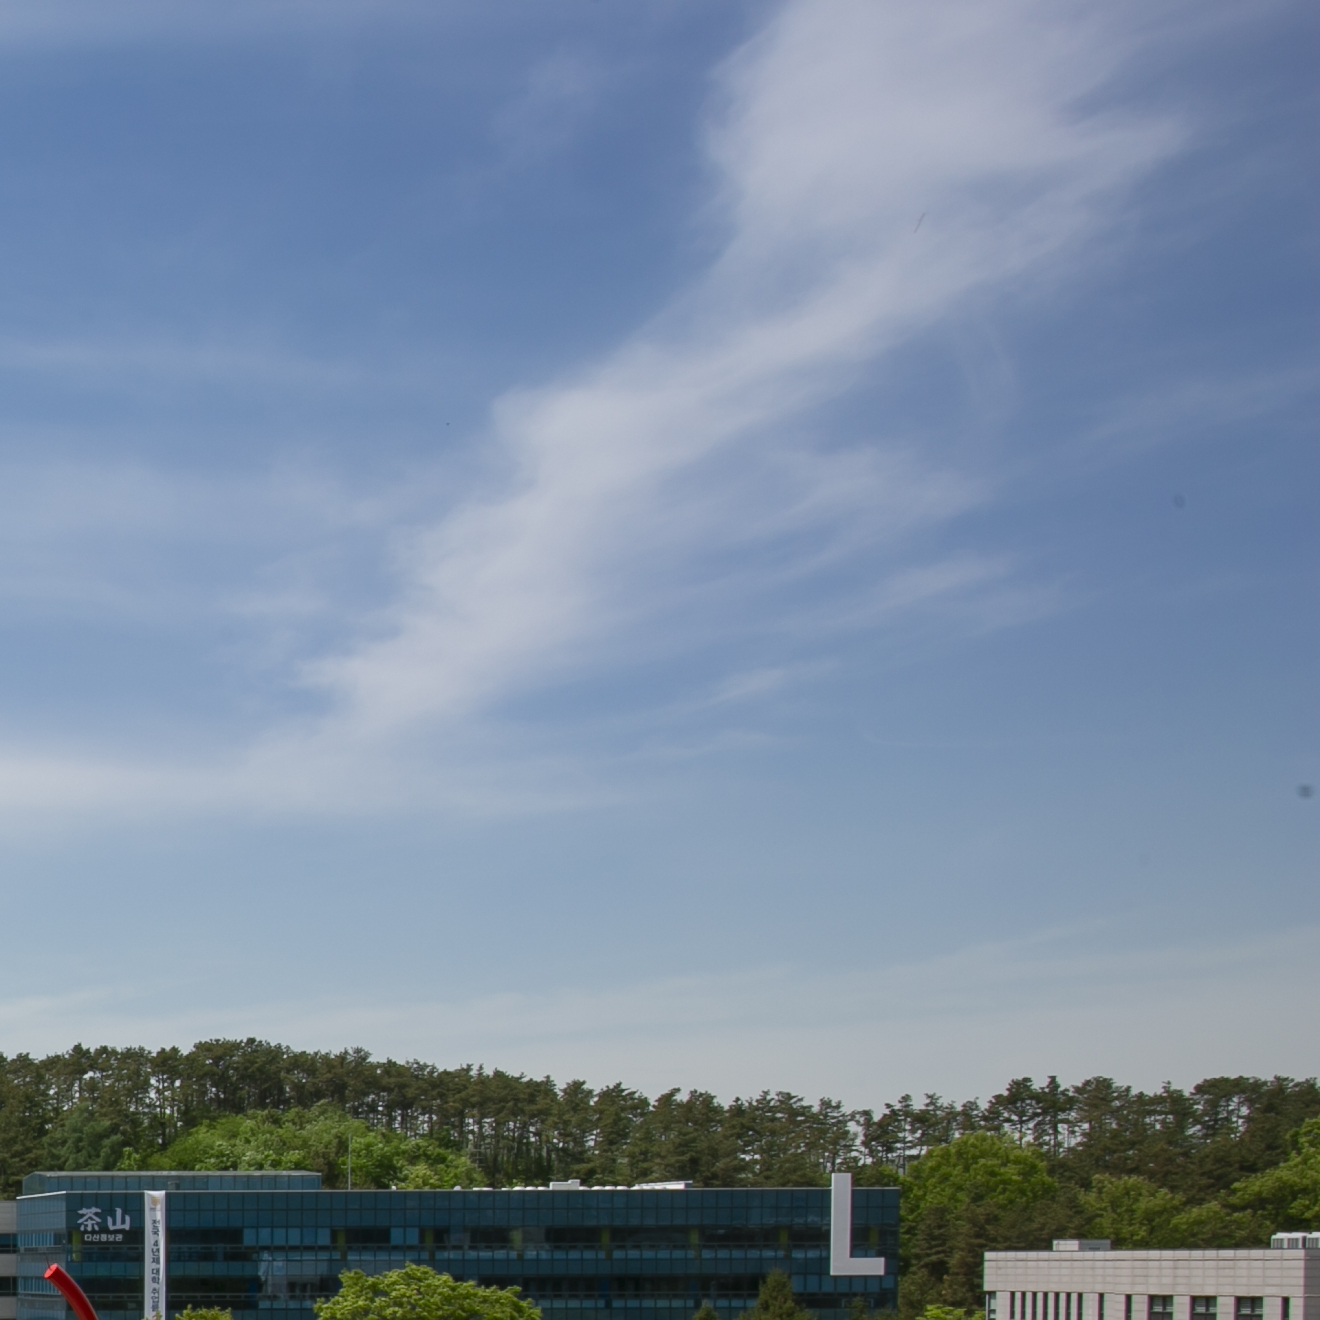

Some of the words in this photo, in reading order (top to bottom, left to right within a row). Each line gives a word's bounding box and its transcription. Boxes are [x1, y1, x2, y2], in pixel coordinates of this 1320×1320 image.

[77, 1206, 130, 1232] 茶山
[151, 1219, 160, 1236] 전국
[830, 1172, 885, 1276] L
[151, 1240, 160, 1265] 4년제
[151, 1268, 160, 1285] 대학
